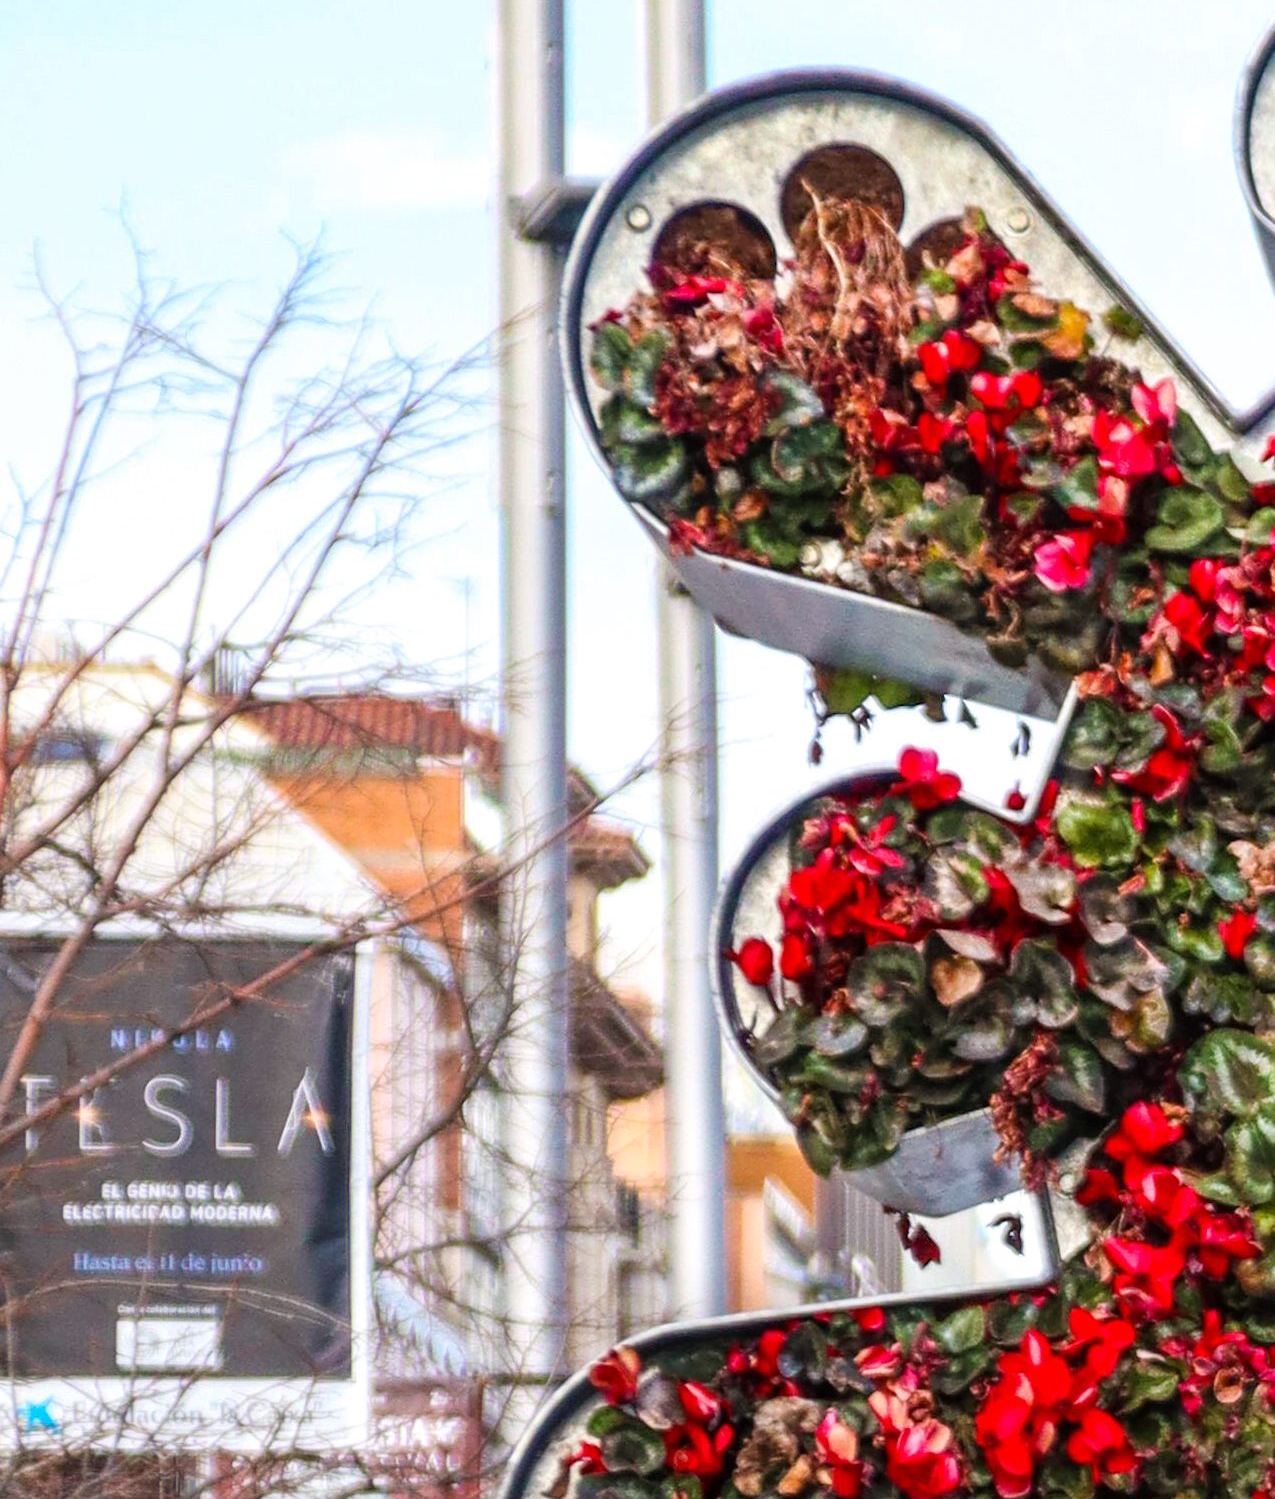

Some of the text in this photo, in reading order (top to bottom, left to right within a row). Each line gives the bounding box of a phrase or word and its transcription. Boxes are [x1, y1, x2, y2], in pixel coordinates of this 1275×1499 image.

[21, 1067, 335, 1156] TESLA
[101, 1182, 123, 1200] EL
[185, 1182, 210, 1200] DE
[213, 1182, 239, 1200] LA
[190, 1204, 277, 1222] MODERNA
[73, 1253, 132, 1271] Hasta
[181, 1253, 206, 1271] de
